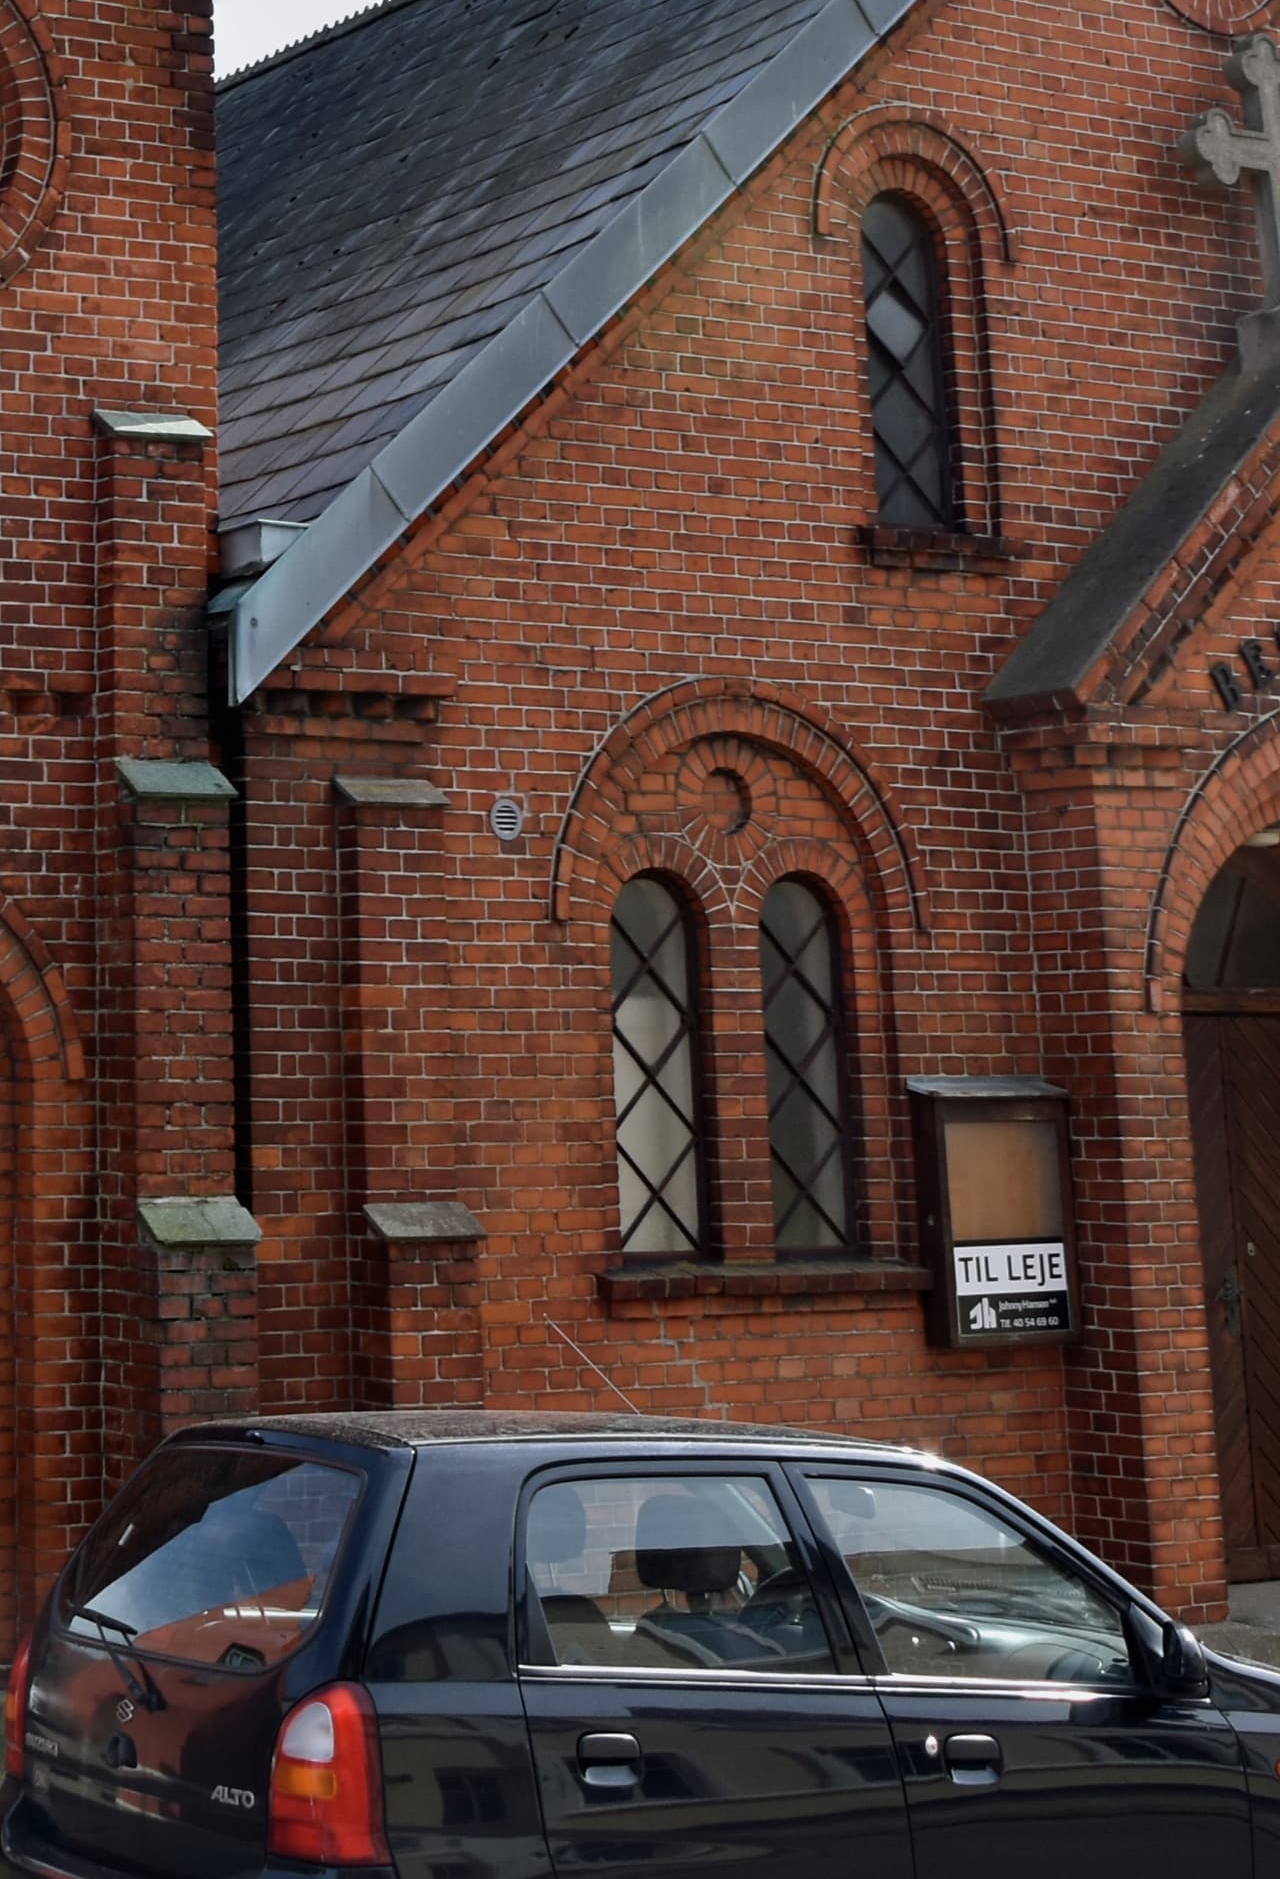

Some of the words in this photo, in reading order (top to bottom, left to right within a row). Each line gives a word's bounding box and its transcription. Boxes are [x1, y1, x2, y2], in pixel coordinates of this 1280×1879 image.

[958, 1256, 999, 1283] TIL
[1006, 1253, 1063, 1287] LEJE
[211, 1784, 255, 1809] ALTO
